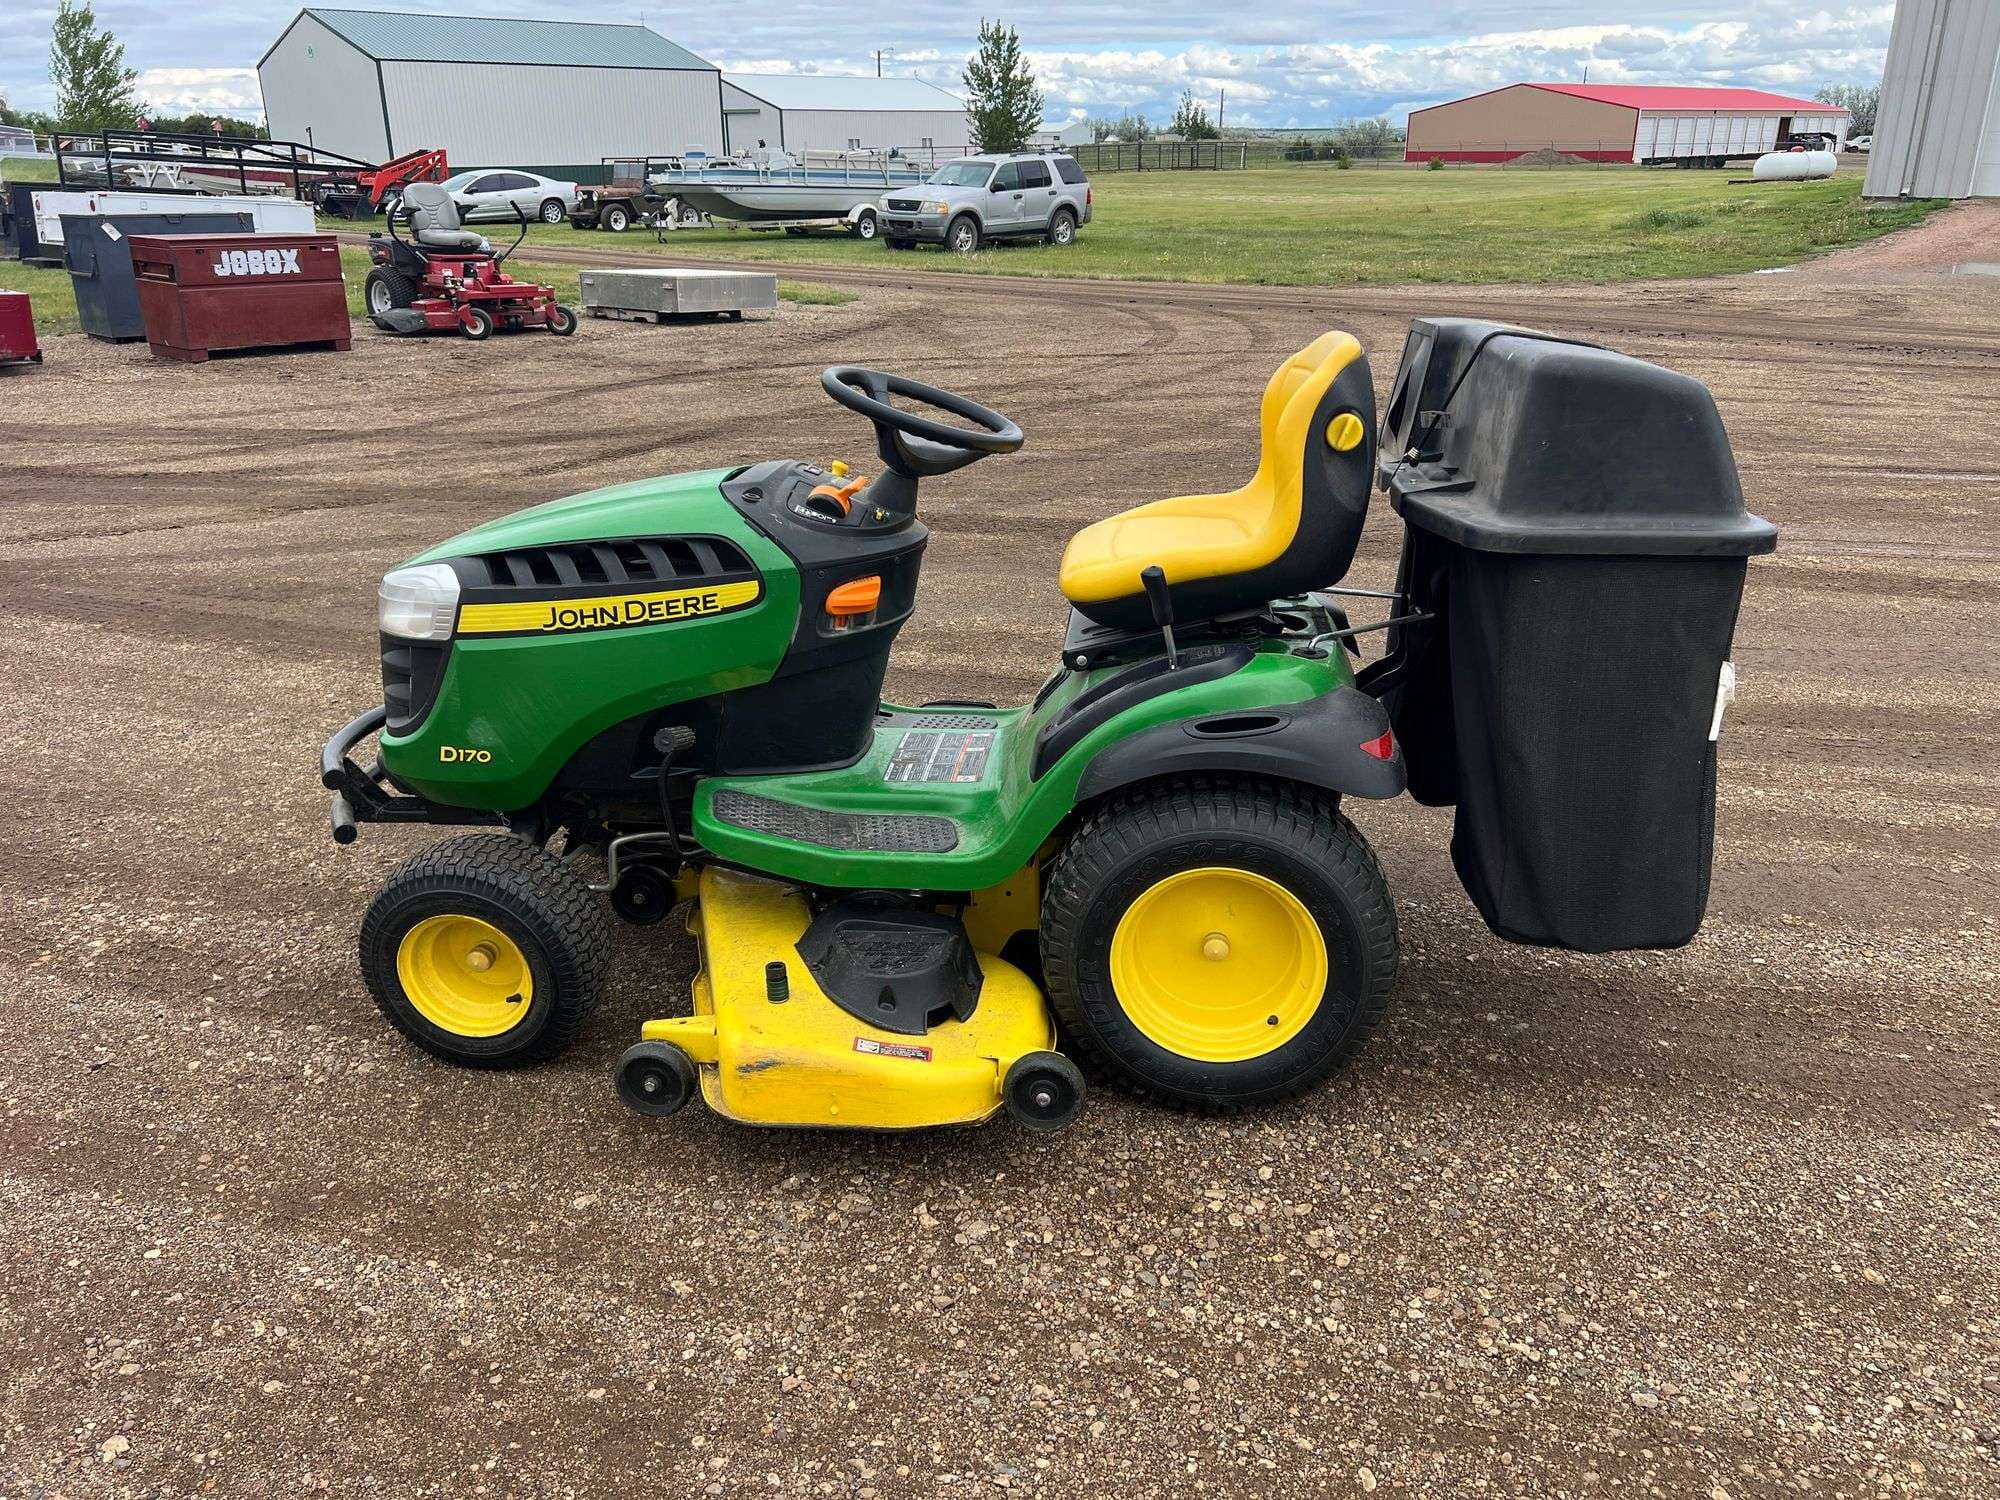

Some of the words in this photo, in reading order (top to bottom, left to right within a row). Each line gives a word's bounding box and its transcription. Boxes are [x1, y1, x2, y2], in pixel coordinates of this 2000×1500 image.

[213, 248, 302, 276] JOBOX
[543, 607, 619, 629] JOHN
[624, 593, 718, 621] DEERE
[439, 745, 492, 763] D170
